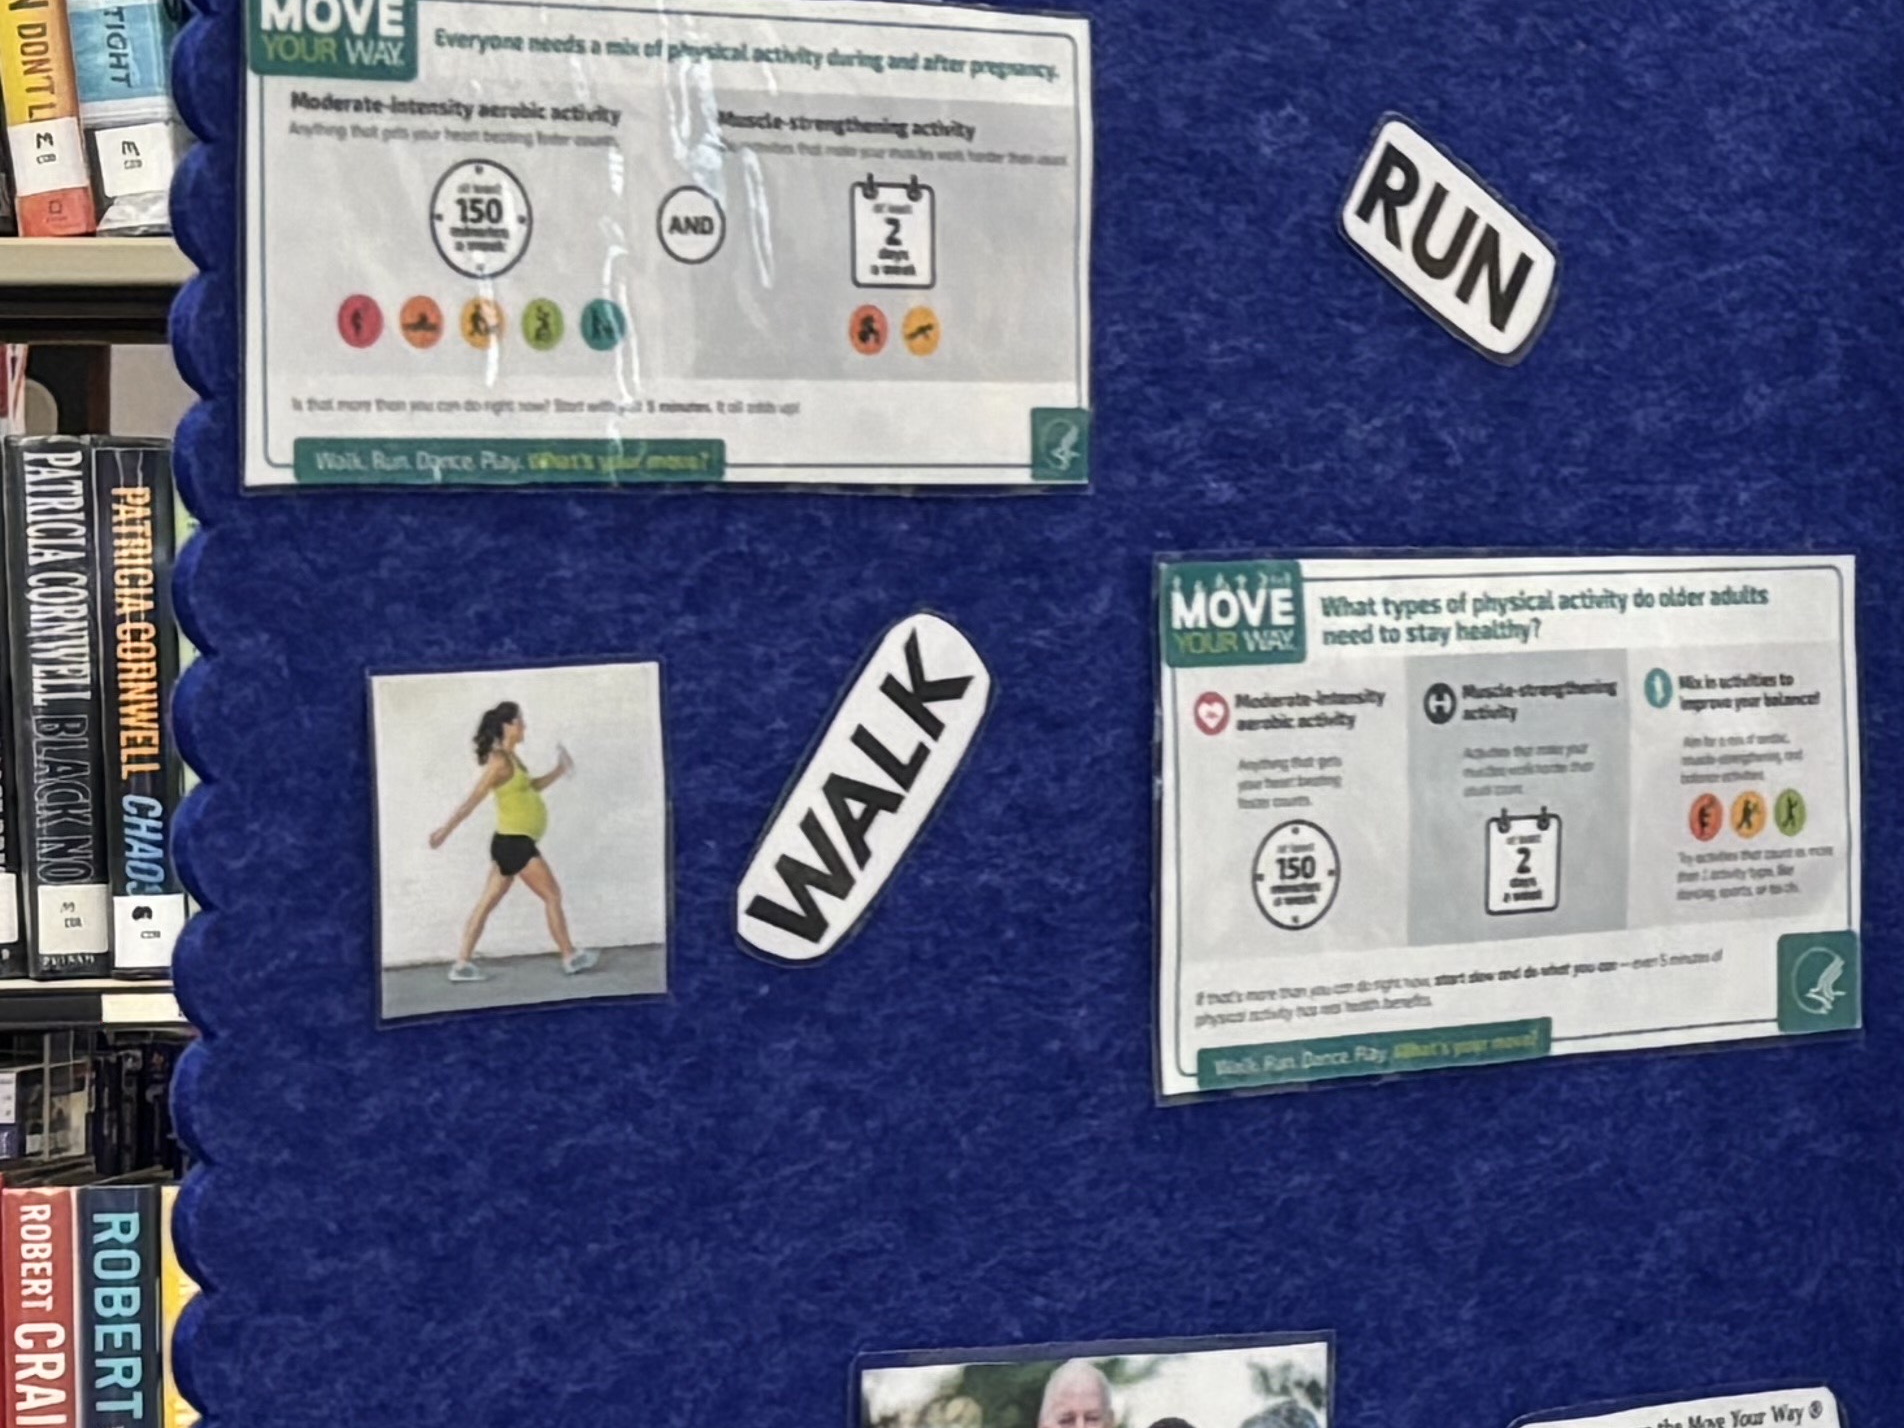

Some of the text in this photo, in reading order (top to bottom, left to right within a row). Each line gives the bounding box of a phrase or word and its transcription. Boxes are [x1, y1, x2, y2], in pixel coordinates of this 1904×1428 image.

[101, 7, 133, 90] TIGHT
[260, 35, 336, 62] YOUR
[454, 196, 504, 227] 150
[667, 213, 715, 236] AND
[1353, 142, 1537, 336] RUN
[22, 450, 88, 566] PATRICIA
[110, 486, 156, 614] PATRICIA
[25, 570, 92, 707] CORNWELL
[1171, 589, 1296, 630] MOVE
[115, 621, 161, 780] CORNWELL
[32, 714, 94, 831] BLACK
[743, 626, 978, 947] WALK
[18, 1203, 54, 1312] ROBERT
[91, 1211, 144, 1420] ROBERT
